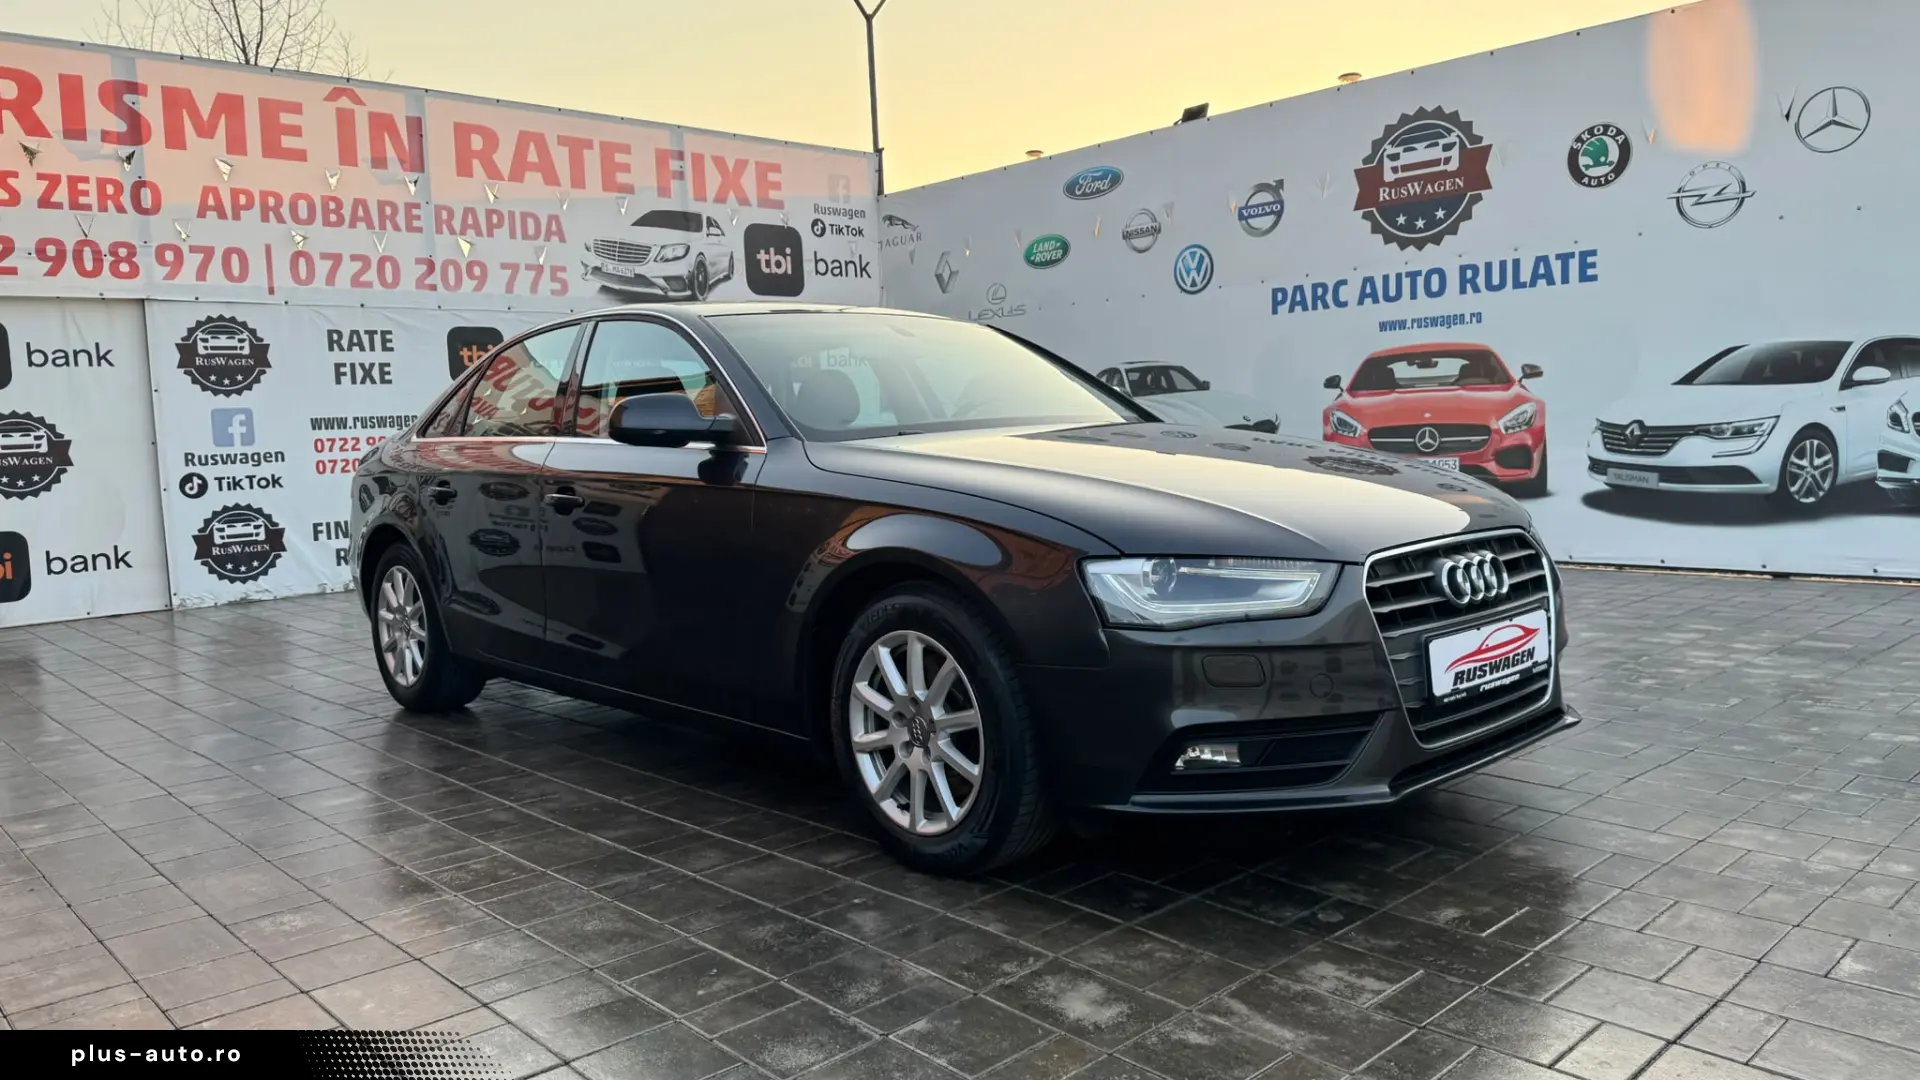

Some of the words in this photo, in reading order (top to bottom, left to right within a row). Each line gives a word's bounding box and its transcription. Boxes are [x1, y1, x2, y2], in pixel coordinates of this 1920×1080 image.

[0, 66, 308, 162] RISME
[323, 86, 426, 173] ÎN
[453, 121, 635, 196] RATE
[655, 147, 784, 210] FIXE
[1573, 126, 1625, 150] SKODA
[1075, 171, 1112, 195] Ford
[1581, 173, 1615, 186] AUTO
[36, 172, 162, 216] ZERO
[197, 185, 424, 233] APROBARE
[434, 204, 567, 244] RAPIDA
[813, 203, 866, 220] Ruswagen
[1241, 202, 1281, 217] VOLVO
[828, 223, 865, 238] TikTok
[1126, 225, 1158, 238] NISSAN
[1033, 240, 1056, 253] LAND
[1035, 249, 1063, 263] ROVER
[34, 236, 140, 280] 908
[154, 243, 249, 283] 970
[289, 250, 400, 290] 0720
[415, 257, 488, 294] 209
[500, 262, 570, 297] 775
[756, 246, 793, 275] tbi
[814, 251, 872, 279] bank
[1271, 278, 1348, 315] PARC
[1357, 267, 1446, 306] AUTO
[1458, 249, 1598, 295] RULATE
[968, 305, 1026, 321] LEXUS
[1378, 311, 1482, 332] www.ruswagen.ro
[327, 329, 394, 353] RATE
[25, 341, 114, 368] bank
[334, 362, 392, 385] FIXE
[314, 437, 360, 453] 0722
[184, 449, 285, 468] Ruswagen
[214, 474, 284, 493] TikTok
[45, 546, 133, 576] bank
[1453, 647, 1536, 687] RUSWAGEN
